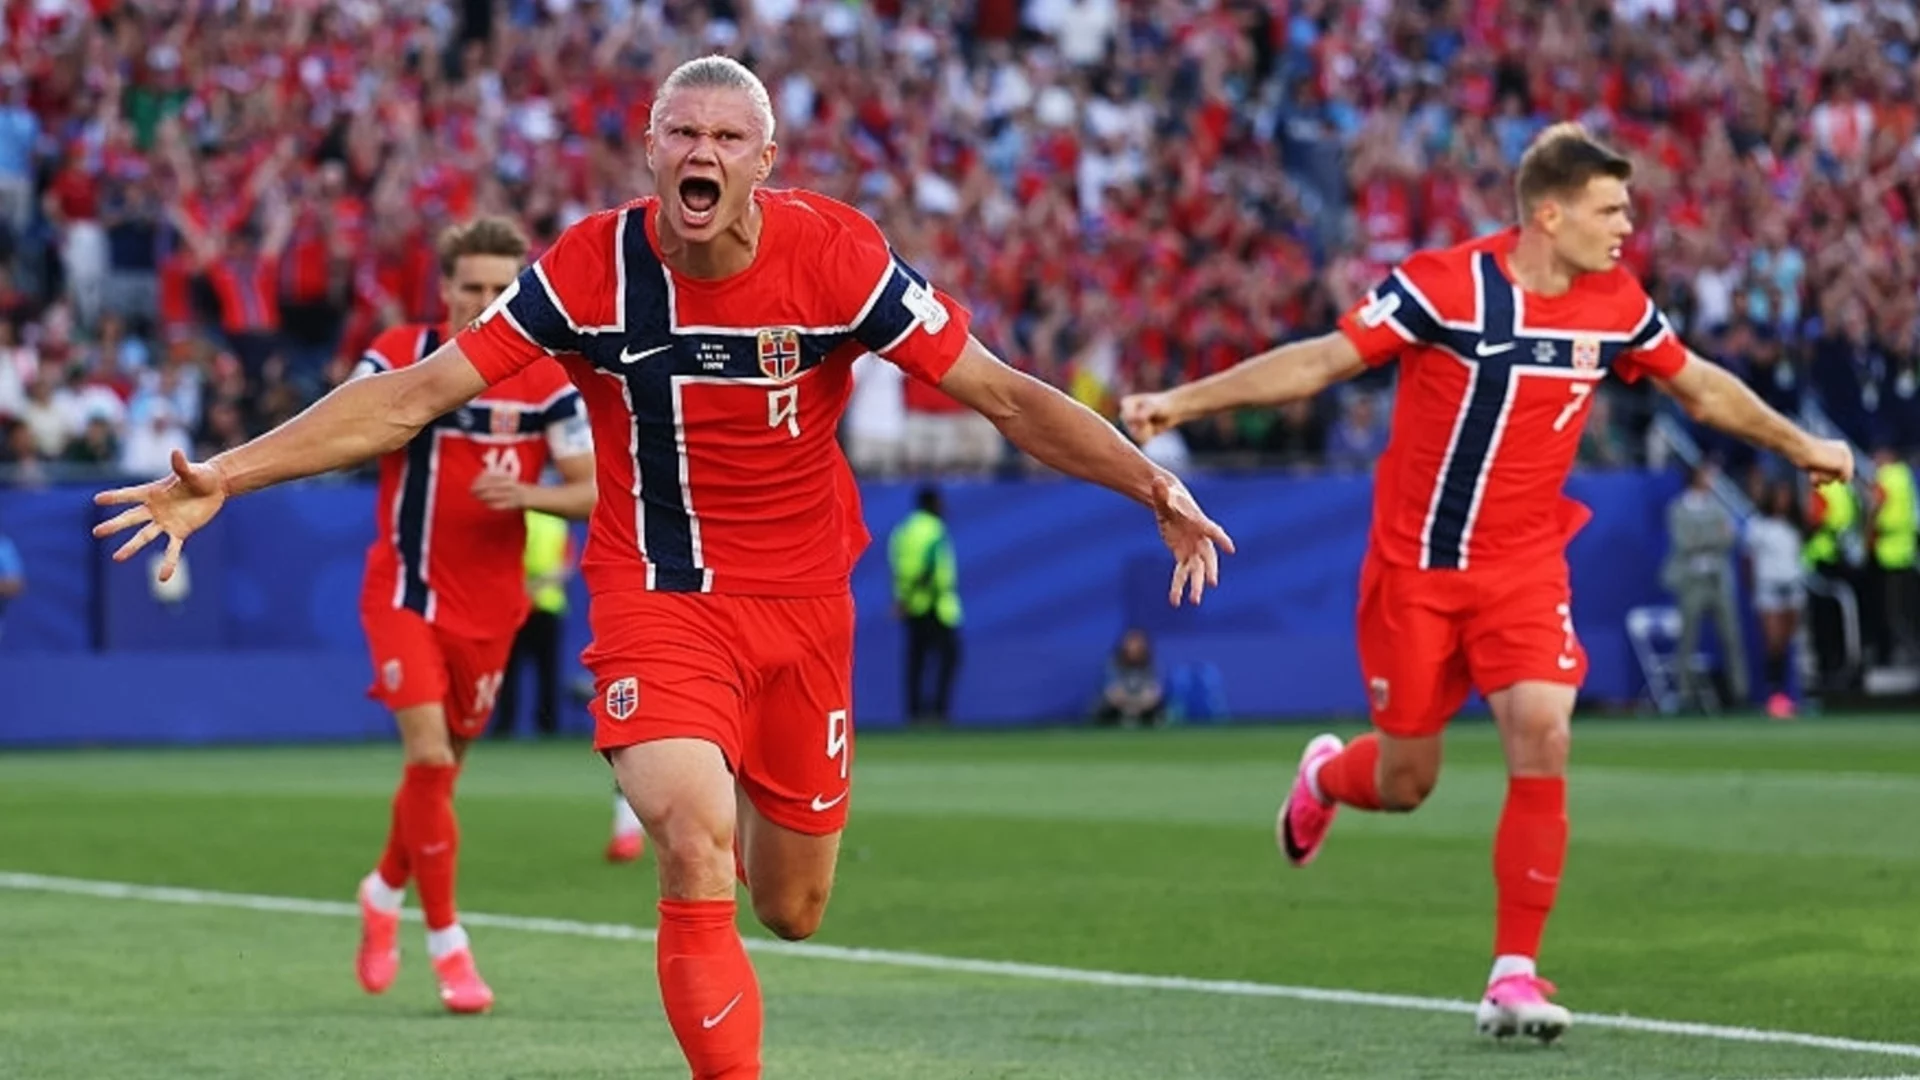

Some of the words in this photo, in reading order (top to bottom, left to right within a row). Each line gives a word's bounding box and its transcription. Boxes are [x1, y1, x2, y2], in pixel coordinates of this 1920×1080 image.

[768, 384, 800, 438] 9
[1553, 382, 1592, 432] 7
[826, 709, 848, 779] 9
